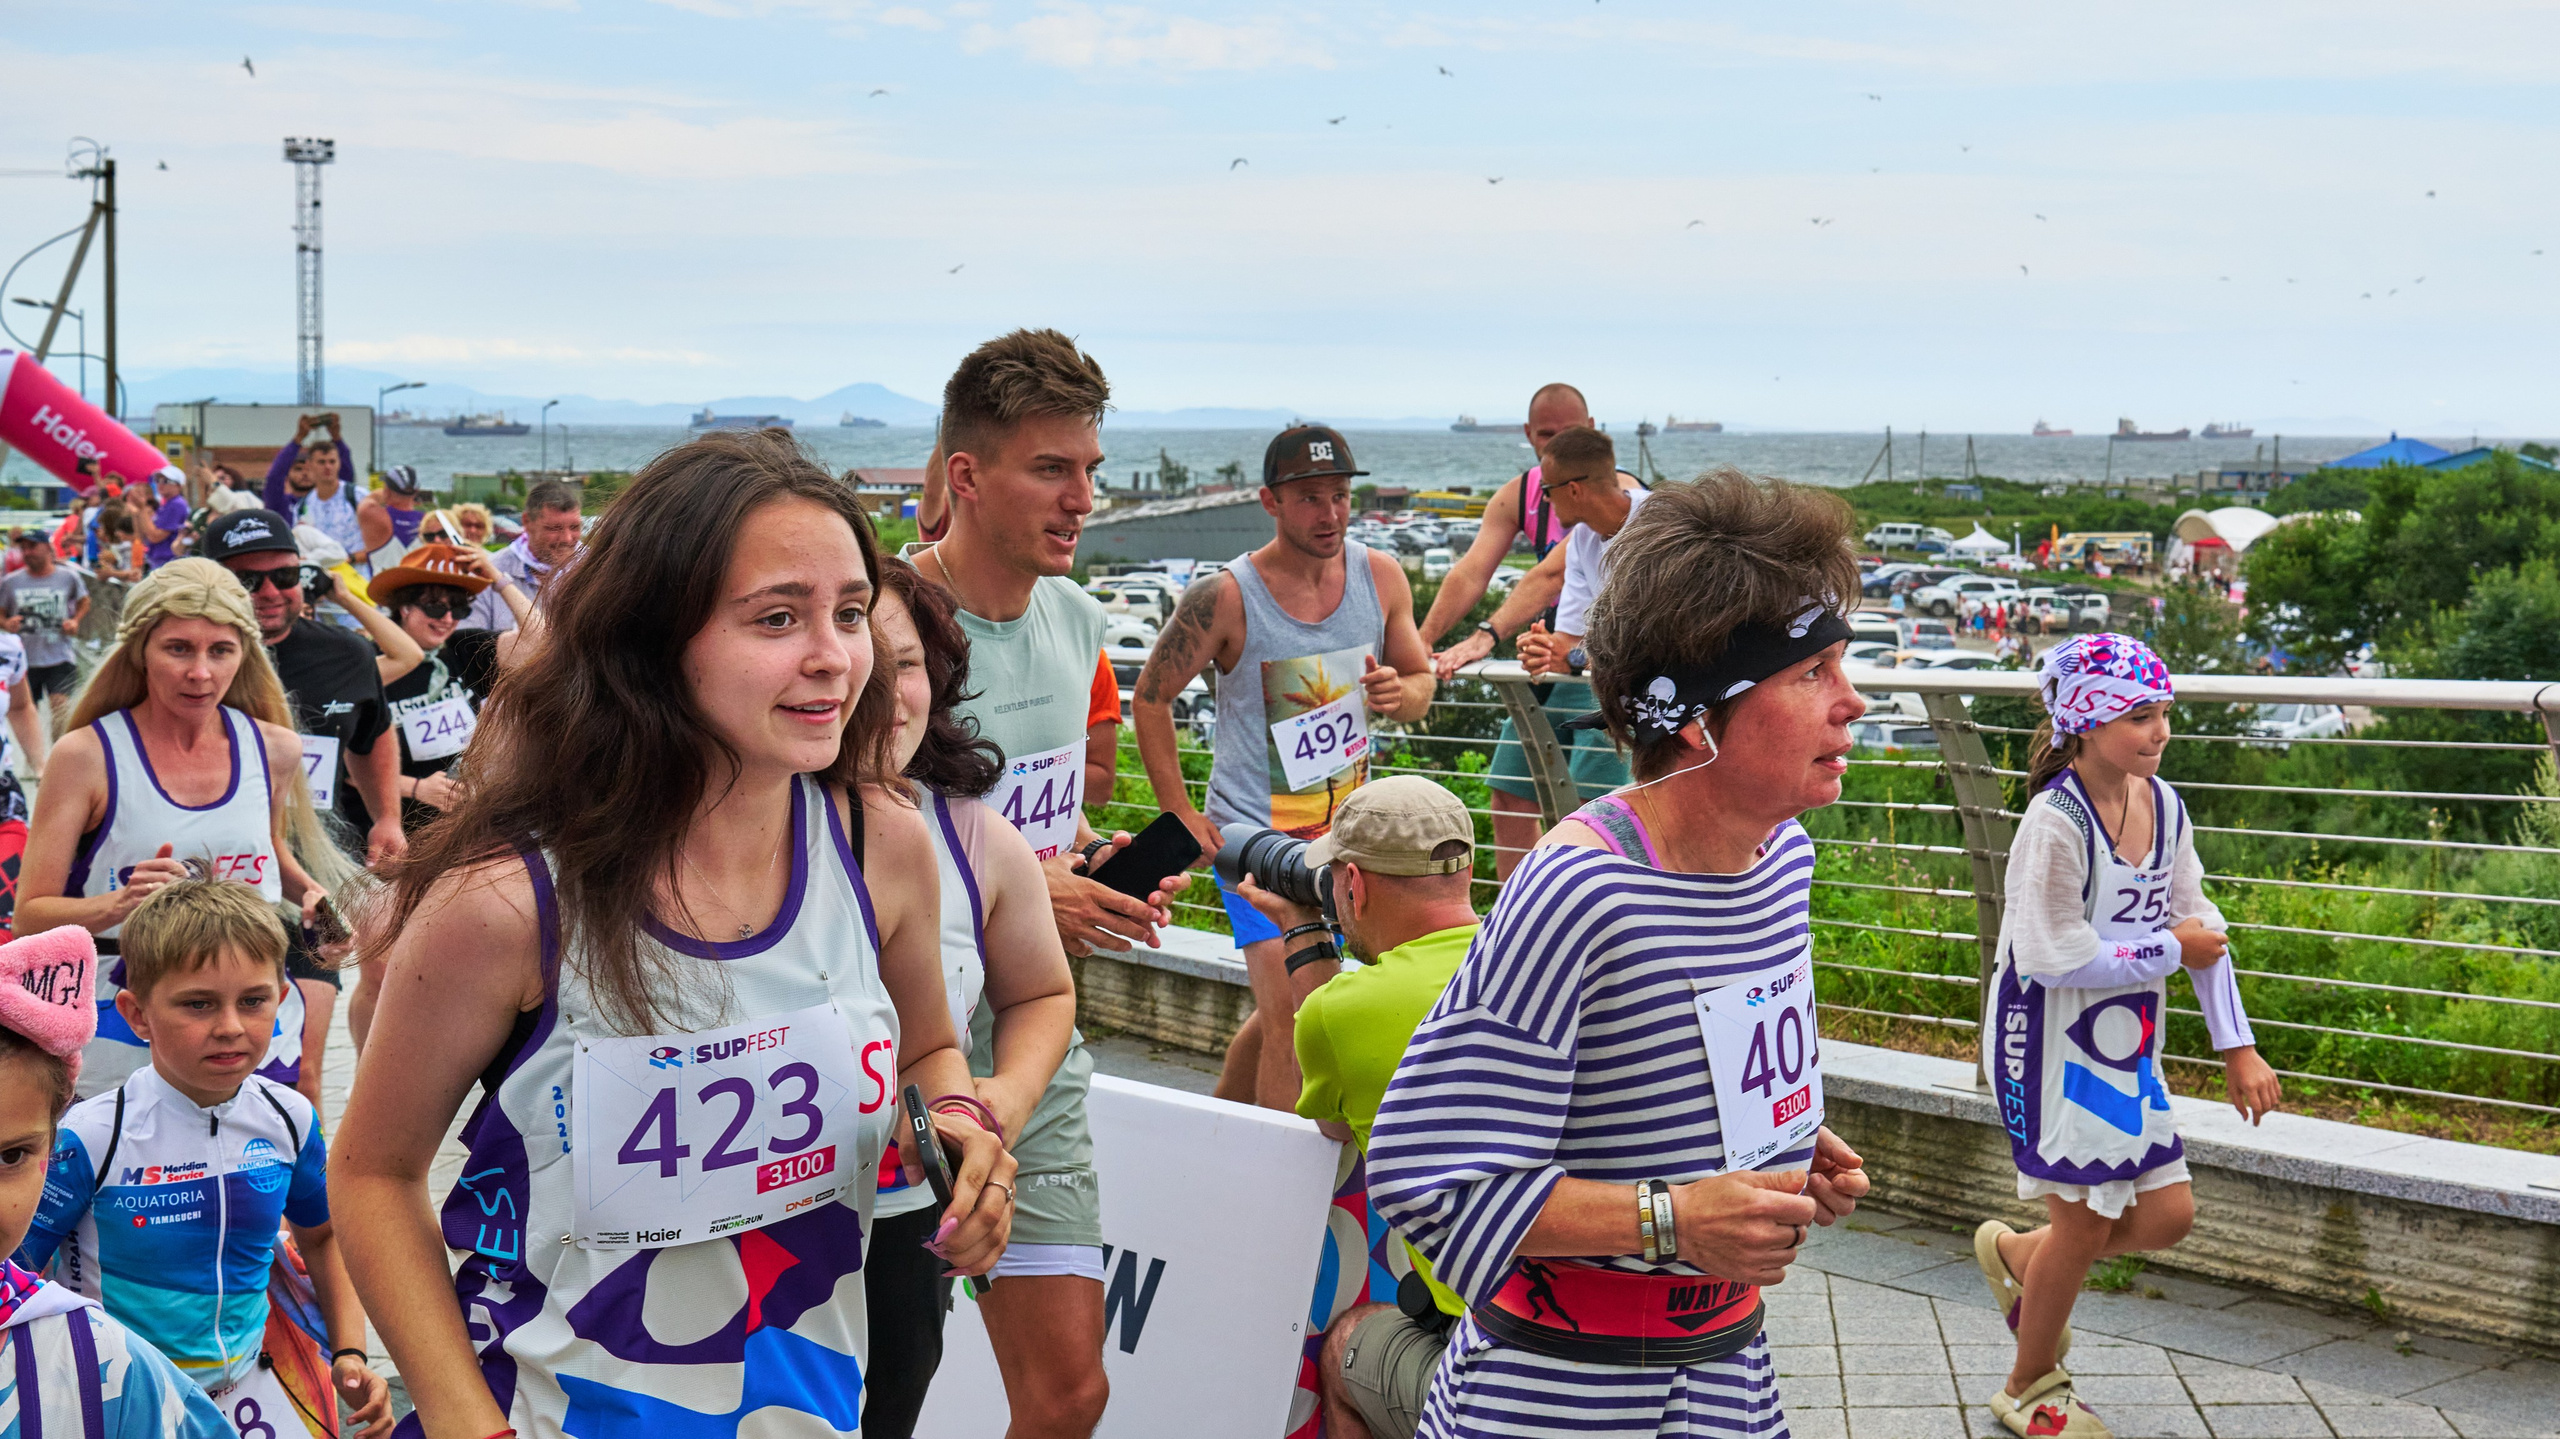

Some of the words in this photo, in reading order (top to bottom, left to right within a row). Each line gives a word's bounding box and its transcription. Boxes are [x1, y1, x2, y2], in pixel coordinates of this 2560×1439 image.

[31, 405, 108, 459] Haier
[416, 709, 468, 744] 244
[1309, 703, 1342, 722] SUPFEST
[1295, 712, 1358, 760] 492
[1032, 751, 1073, 772] SUPFEST
[1002, 770, 1076, 833] 444
[1770, 960, 1808, 998] SUPFEST
[696, 1026, 790, 1064] SUPFEST
[1741, 989, 1820, 1099] 401
[2004, 1011, 2029, 1147] SUPFEST
[617, 1062, 824, 1178] 423
[1779, 1091, 1807, 1122] 3100
[119, 1166, 163, 1186] MS
[163, 1161, 208, 1174] Meridian
[167, 1171, 205, 1183] Service
[768, 1152, 825, 1187] 3100
[114, 1189, 206, 1213] AQUATORIA
[150, 1210, 202, 1225] YAMAGUCHI
[785, 1196, 814, 1212] DNS
[636, 1228, 682, 1243] Haier
[1666, 1281, 1725, 1312] WAY
